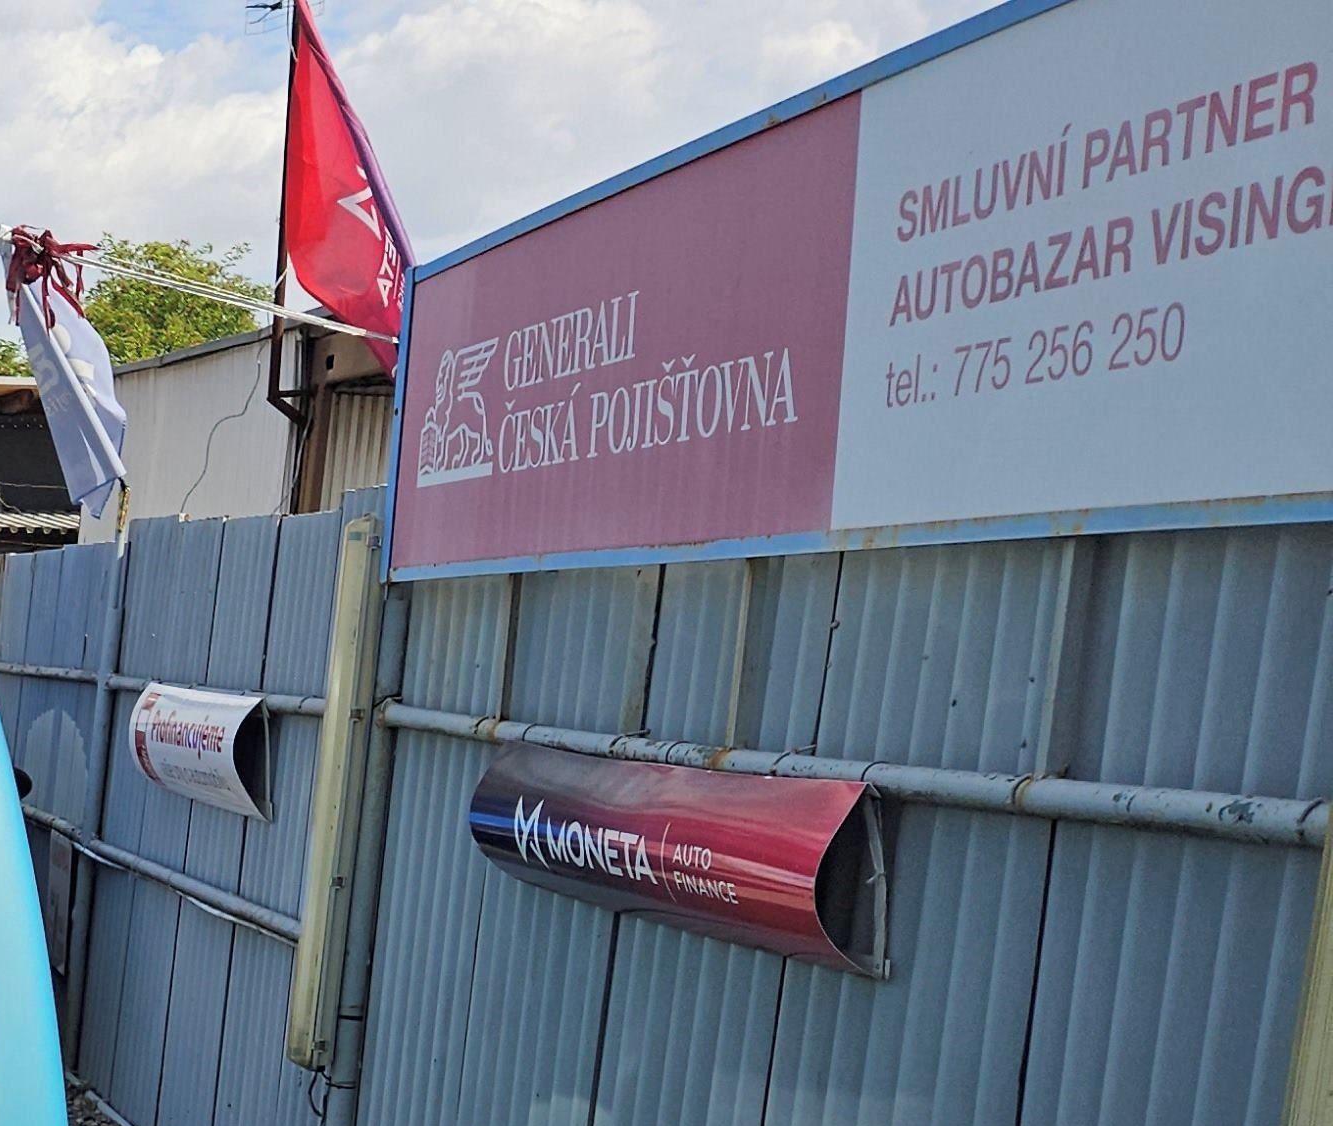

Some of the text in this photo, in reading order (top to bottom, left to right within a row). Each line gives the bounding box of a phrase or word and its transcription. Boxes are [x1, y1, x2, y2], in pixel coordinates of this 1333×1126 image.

[896, 61, 1319, 243] SMLUVNÍ PARTNER
[888, 215, 1134, 328] AUTOBAZAR
[503, 289, 640, 392] GENERALI
[886, 301, 1186, 409] tel.: 775 256 250
[497, 347, 798, 474] ČESKÁ POJIŠŤOVNA
[547, 815, 659, 885] MONETA
[672, 843, 712, 871] AUTO
[673, 871, 739, 905] FINANCE
